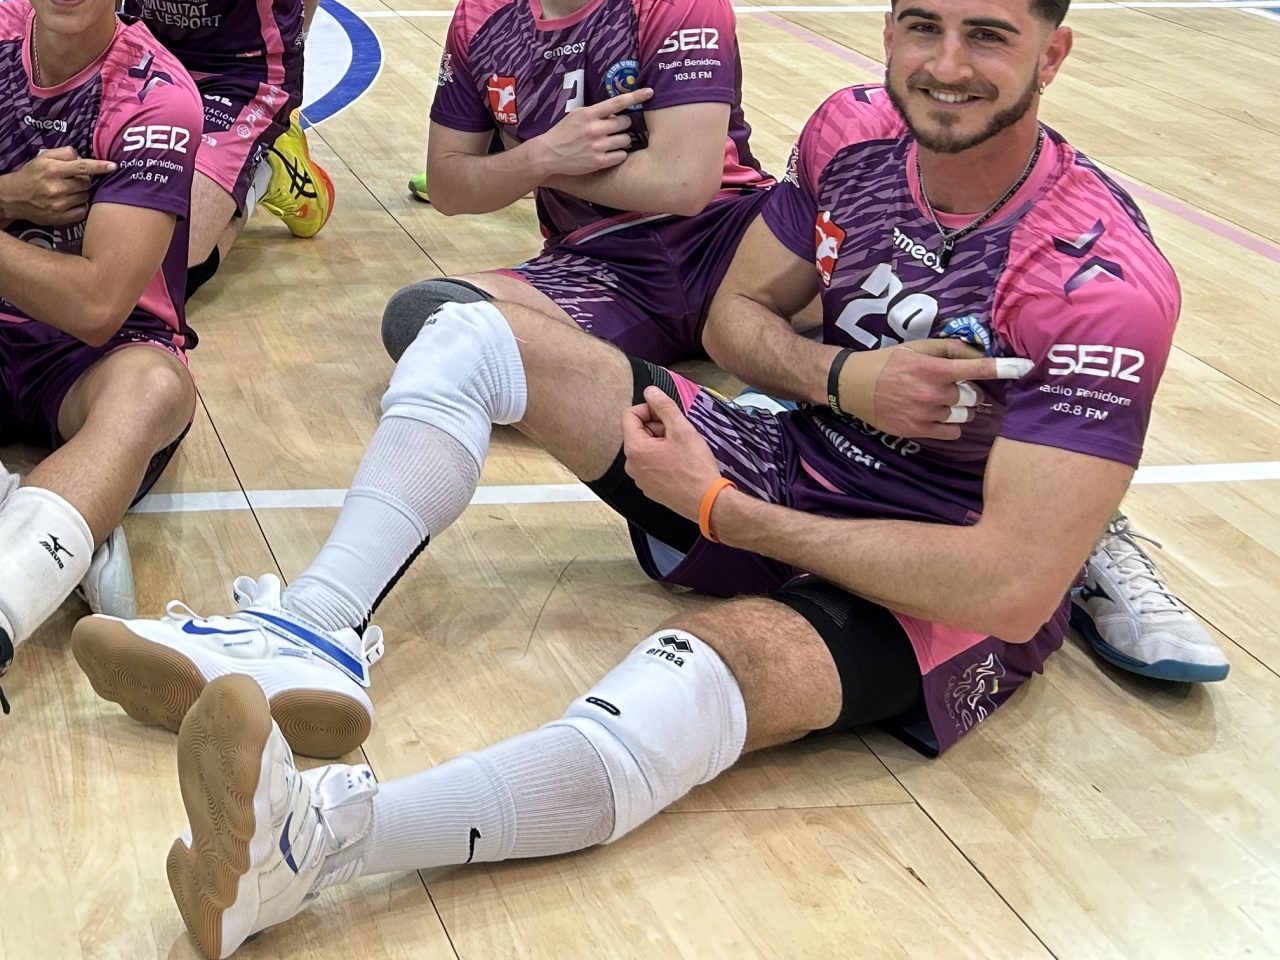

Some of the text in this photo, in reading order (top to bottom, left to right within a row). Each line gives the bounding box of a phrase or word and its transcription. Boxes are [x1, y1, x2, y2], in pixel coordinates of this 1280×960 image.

[657, 28, 719, 54] SER
[658, 56, 721, 71] Radio Benidorm
[674, 71, 712, 82] 103.8 FM
[122, 125, 190, 154] SER
[146, 158, 184, 173] Benidorm
[154, 173, 169, 184] FM
[1047, 344, 1145, 383] SER
[1085, 407, 1108, 421] FM
[645, 647, 686, 668] errea
